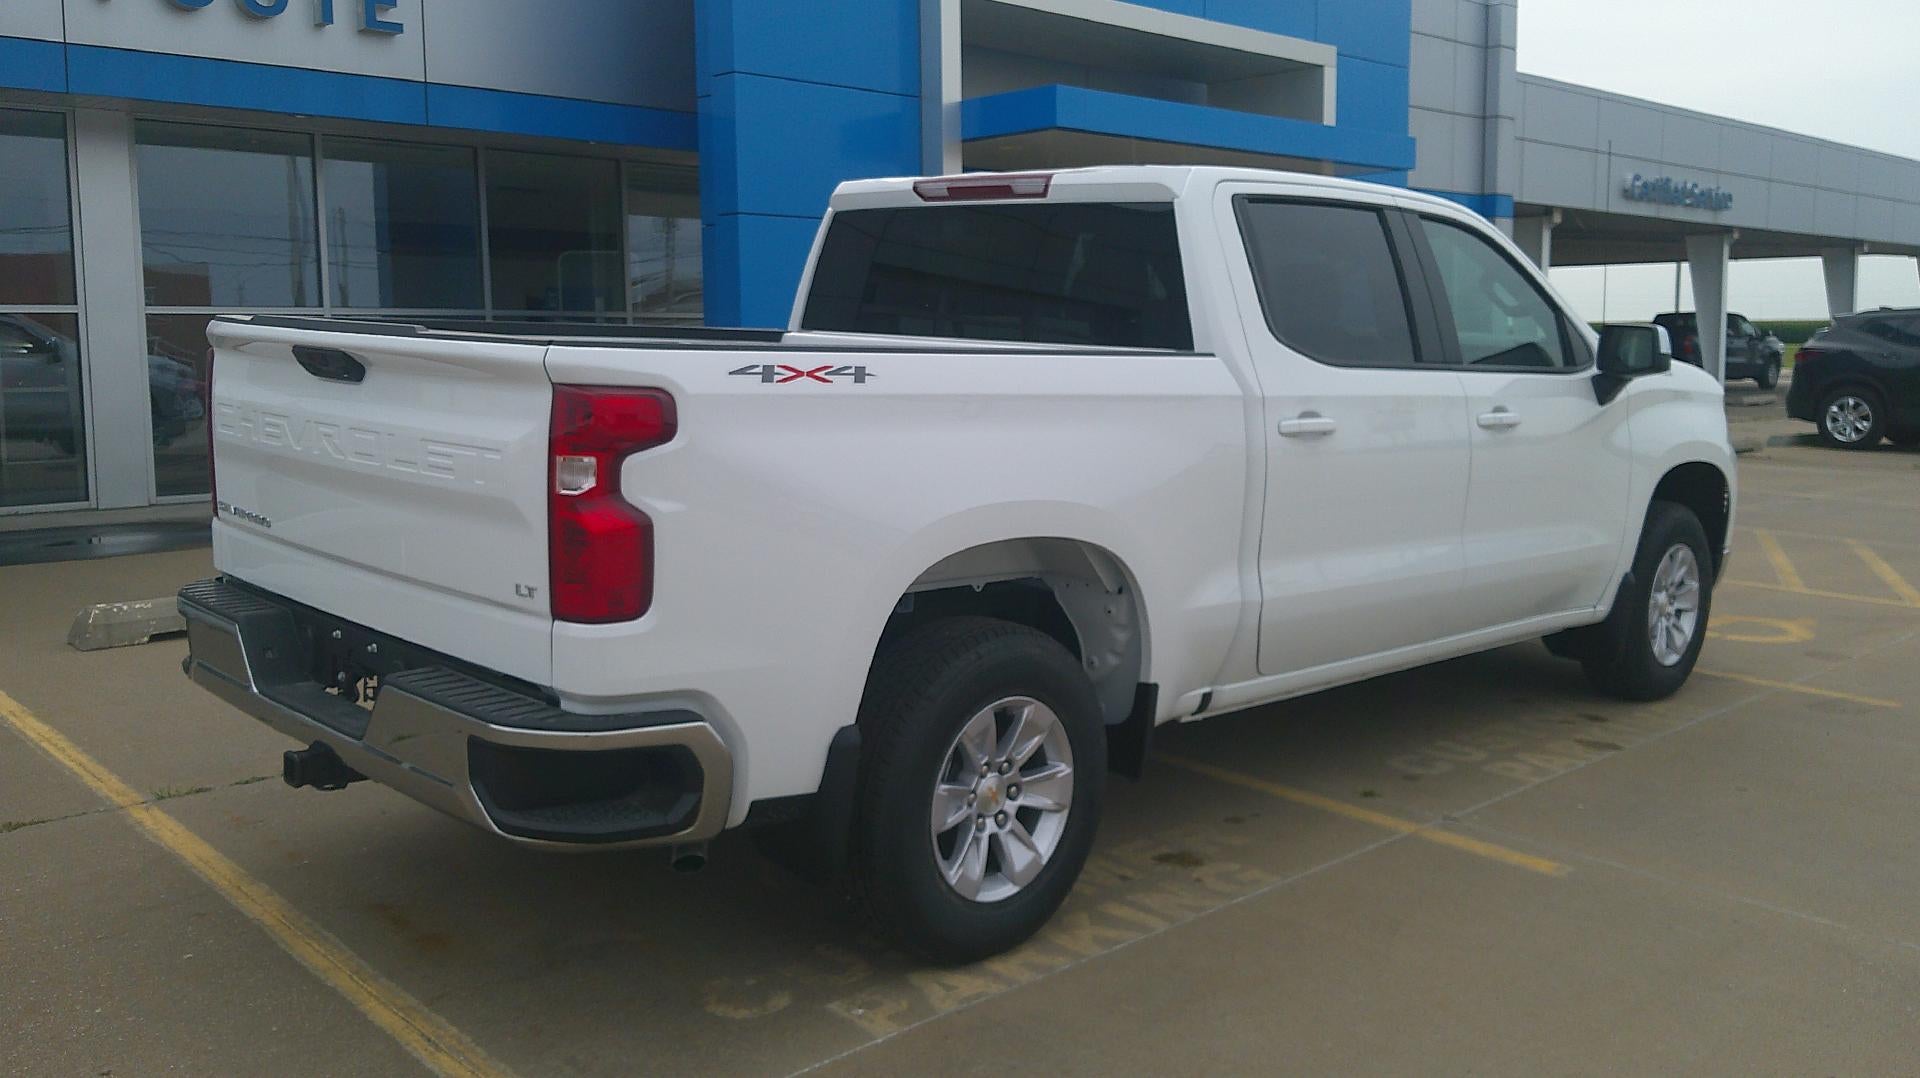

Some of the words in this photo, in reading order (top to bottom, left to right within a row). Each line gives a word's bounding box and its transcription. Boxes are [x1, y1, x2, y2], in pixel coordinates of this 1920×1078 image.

[728, 364, 877, 384] 4X4
[216, 402, 502, 484] CHEVROLET
[515, 583, 537, 600] LT
